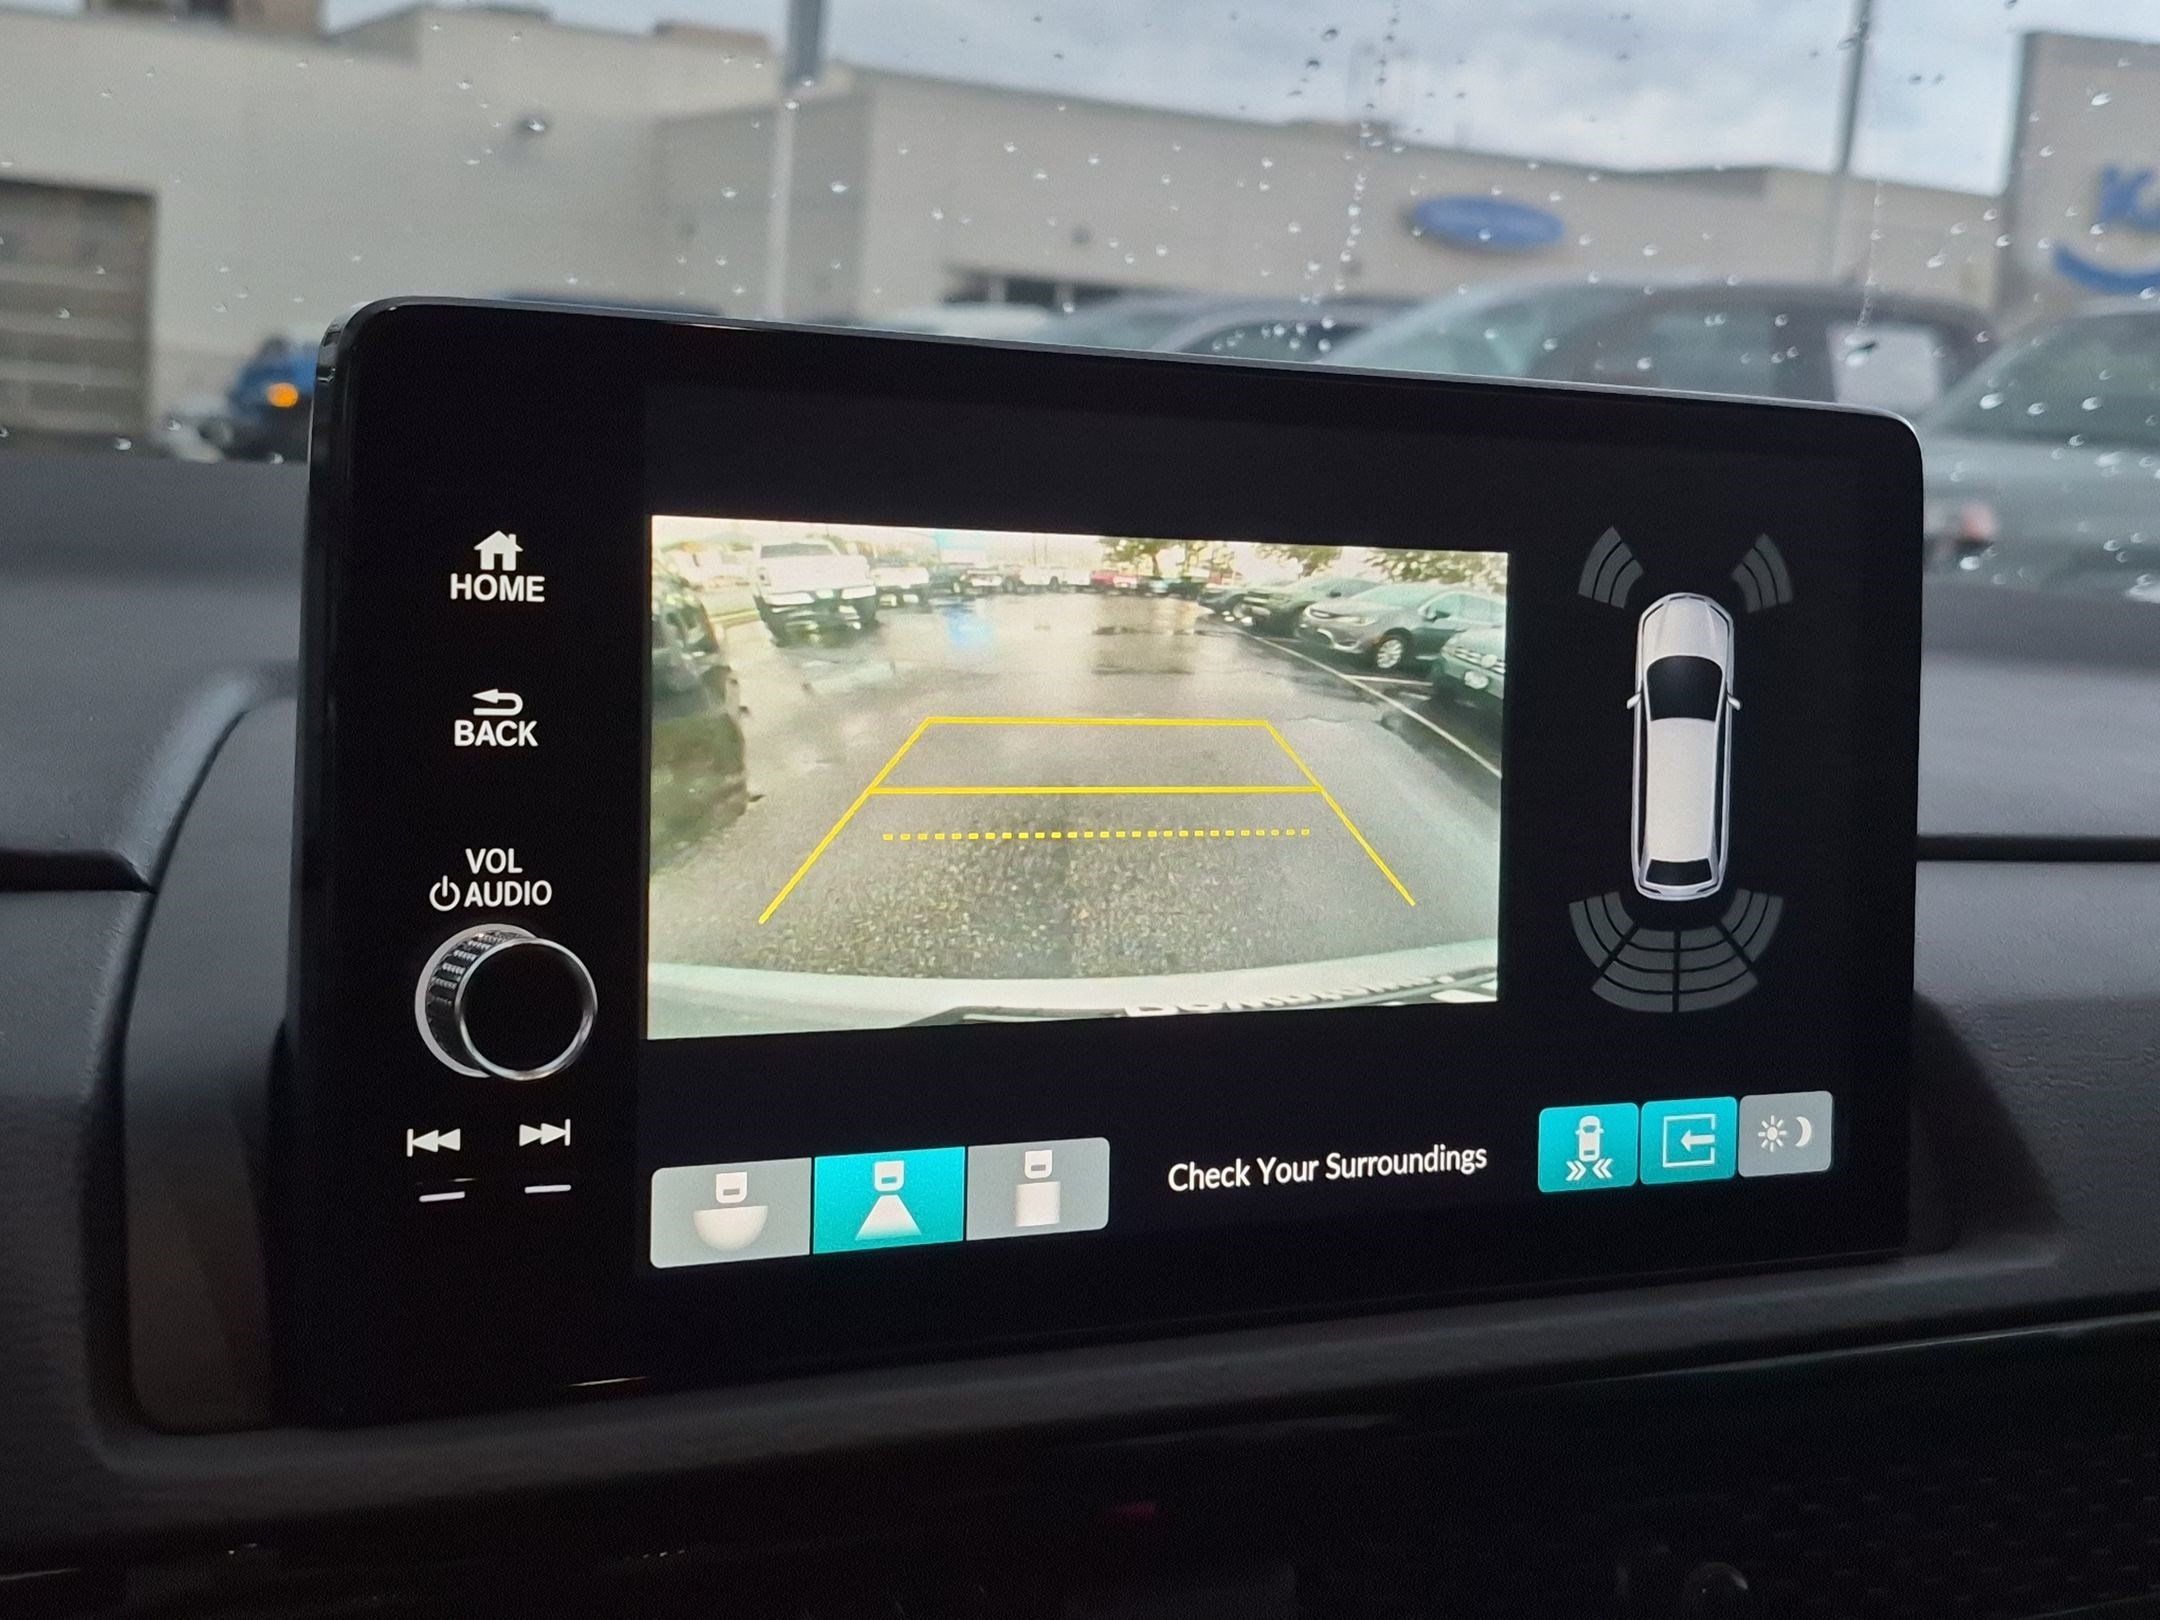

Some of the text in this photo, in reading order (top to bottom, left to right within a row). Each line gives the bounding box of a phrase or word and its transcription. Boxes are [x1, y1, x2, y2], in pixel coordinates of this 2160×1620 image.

[451, 573, 545, 602] HOME
[454, 719, 538, 747] BACK
[465, 847, 523, 874] VOL
[464, 880, 552, 908] AUDIO
[1168, 1144, 1487, 1191] Check Your Surroundings
